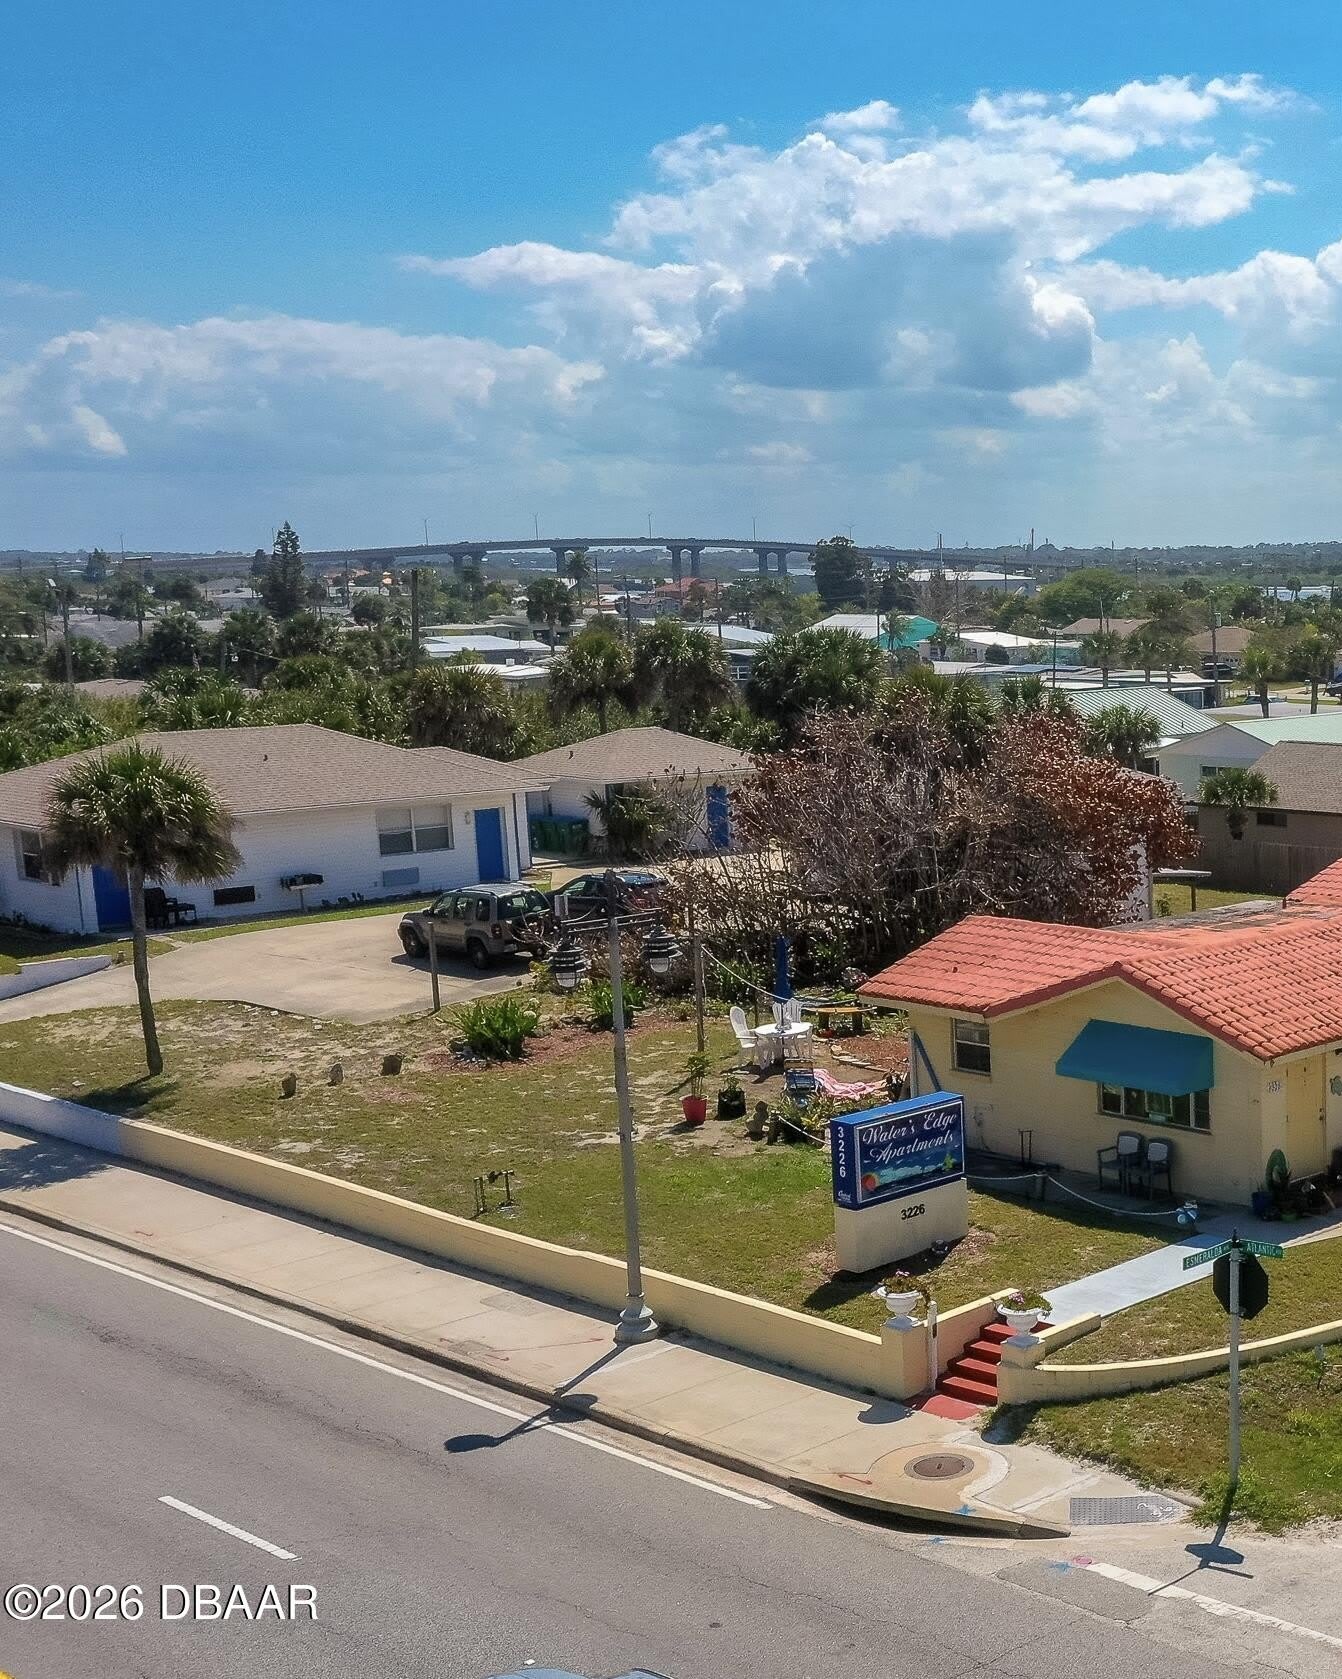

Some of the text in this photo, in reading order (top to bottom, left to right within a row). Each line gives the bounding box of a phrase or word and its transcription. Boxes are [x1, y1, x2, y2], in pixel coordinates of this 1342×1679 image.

[862, 1111, 957, 1145] Water's Edge
[837, 1126, 846, 1178] 3226
[869, 1129, 954, 1165] Apartments
[900, 1204, 925, 1221] 3226
[1185, 1246, 1223, 1268] ESMERALDA
[1246, 1242, 1276, 1256] ATLANTIC
